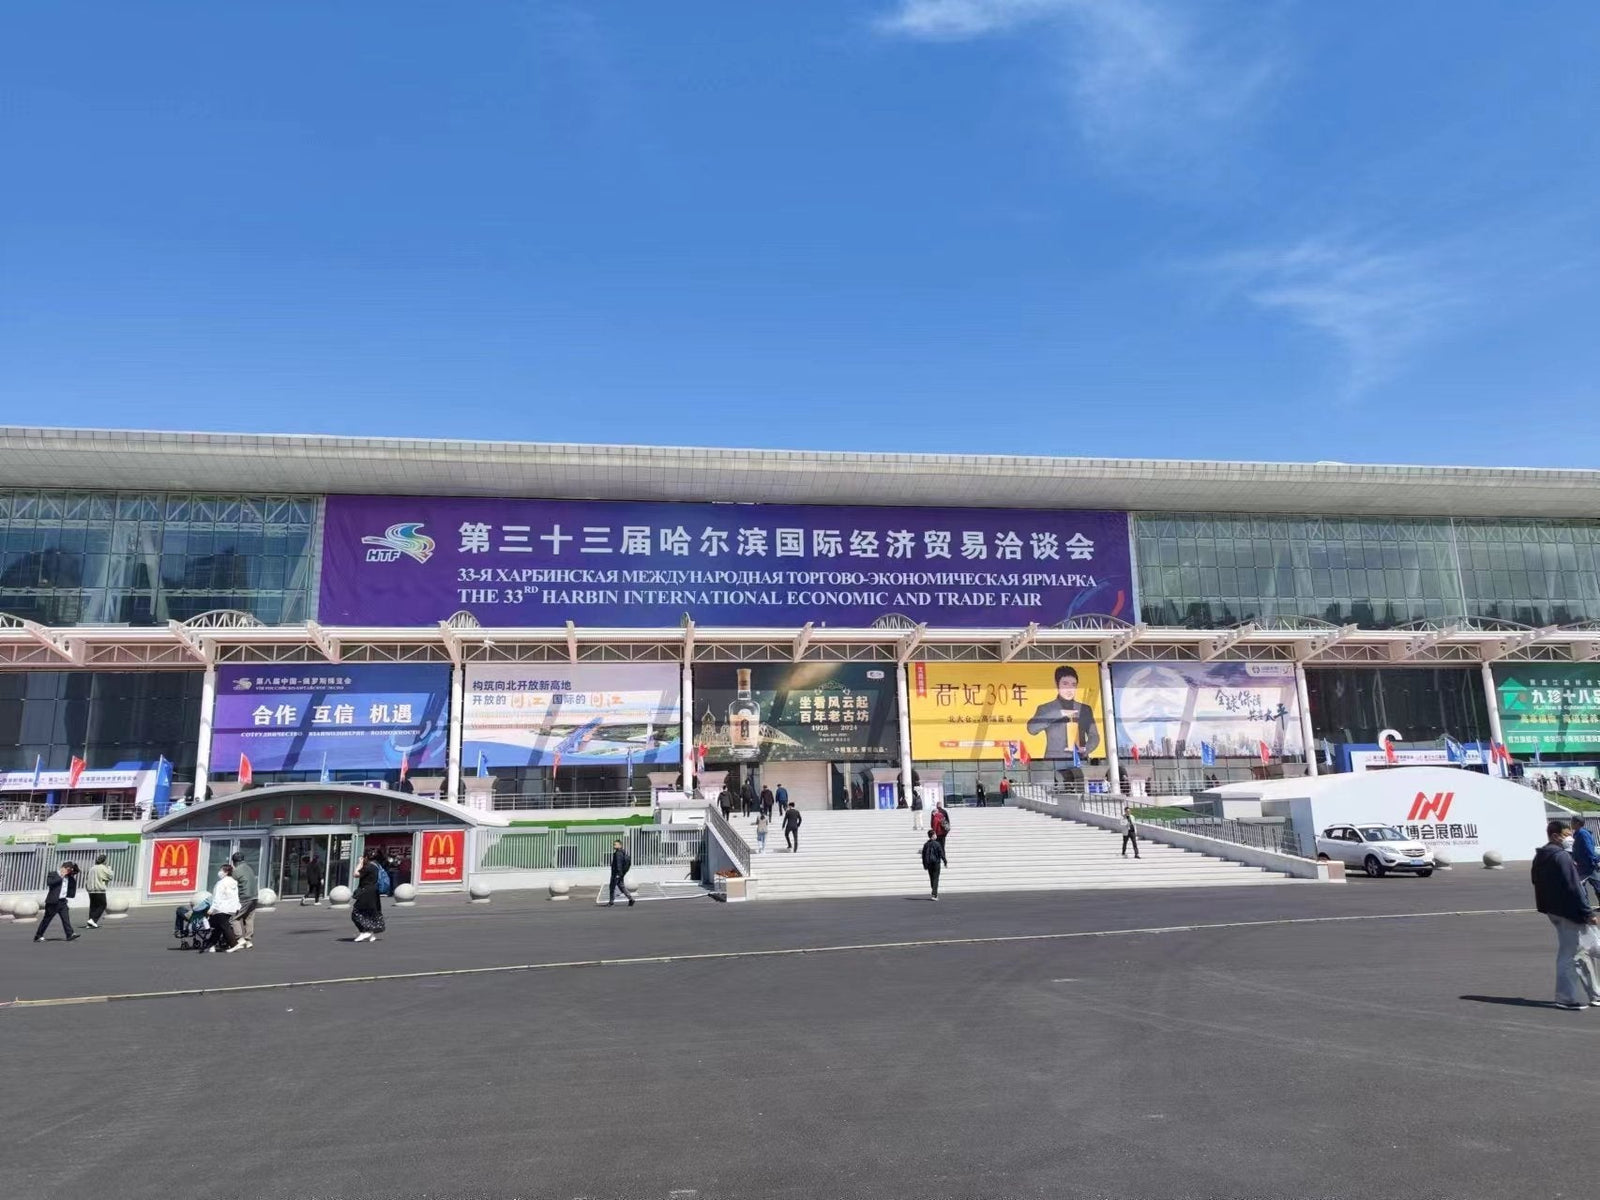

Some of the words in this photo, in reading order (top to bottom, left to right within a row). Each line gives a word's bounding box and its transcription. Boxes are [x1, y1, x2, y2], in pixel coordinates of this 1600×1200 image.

[457, 522, 1095, 561] 第三十三届哈尔滨国际经济贸易洽谈会
[366, 549, 400, 562] HTF
[457, 568, 493, 582] 33-Я
[496, 569, 618, 583] ХАРБИНСКАЯ
[622, 570, 783, 586] МЕЖДУНАРОДНАЯ
[786, 572, 1018, 586] ТОРГОВО-ЭКОНОМИЧЕСКАЯ
[1022, 574, 1096, 587] ЯРМАРКА
[457, 589, 499, 604] THE
[542, 590, 618, 604] HARBIN
[623, 590, 783, 605] INTERNATIONAL
[787, 592, 889, 606] ECONOMIC
[893, 592, 936, 606] AND
[938, 593, 996, 606] TRADE
[1000, 593, 1042, 607] FAIR
[472, 680, 572, 691] 构筑向北开放新高地
[799, 695, 869, 709] 坐看风云起
[252, 704, 297, 726] 合作
[311, 703, 355, 725] 互信
[369, 703, 412, 724] 机遇
[799, 710, 869, 723] 百年老古坊
